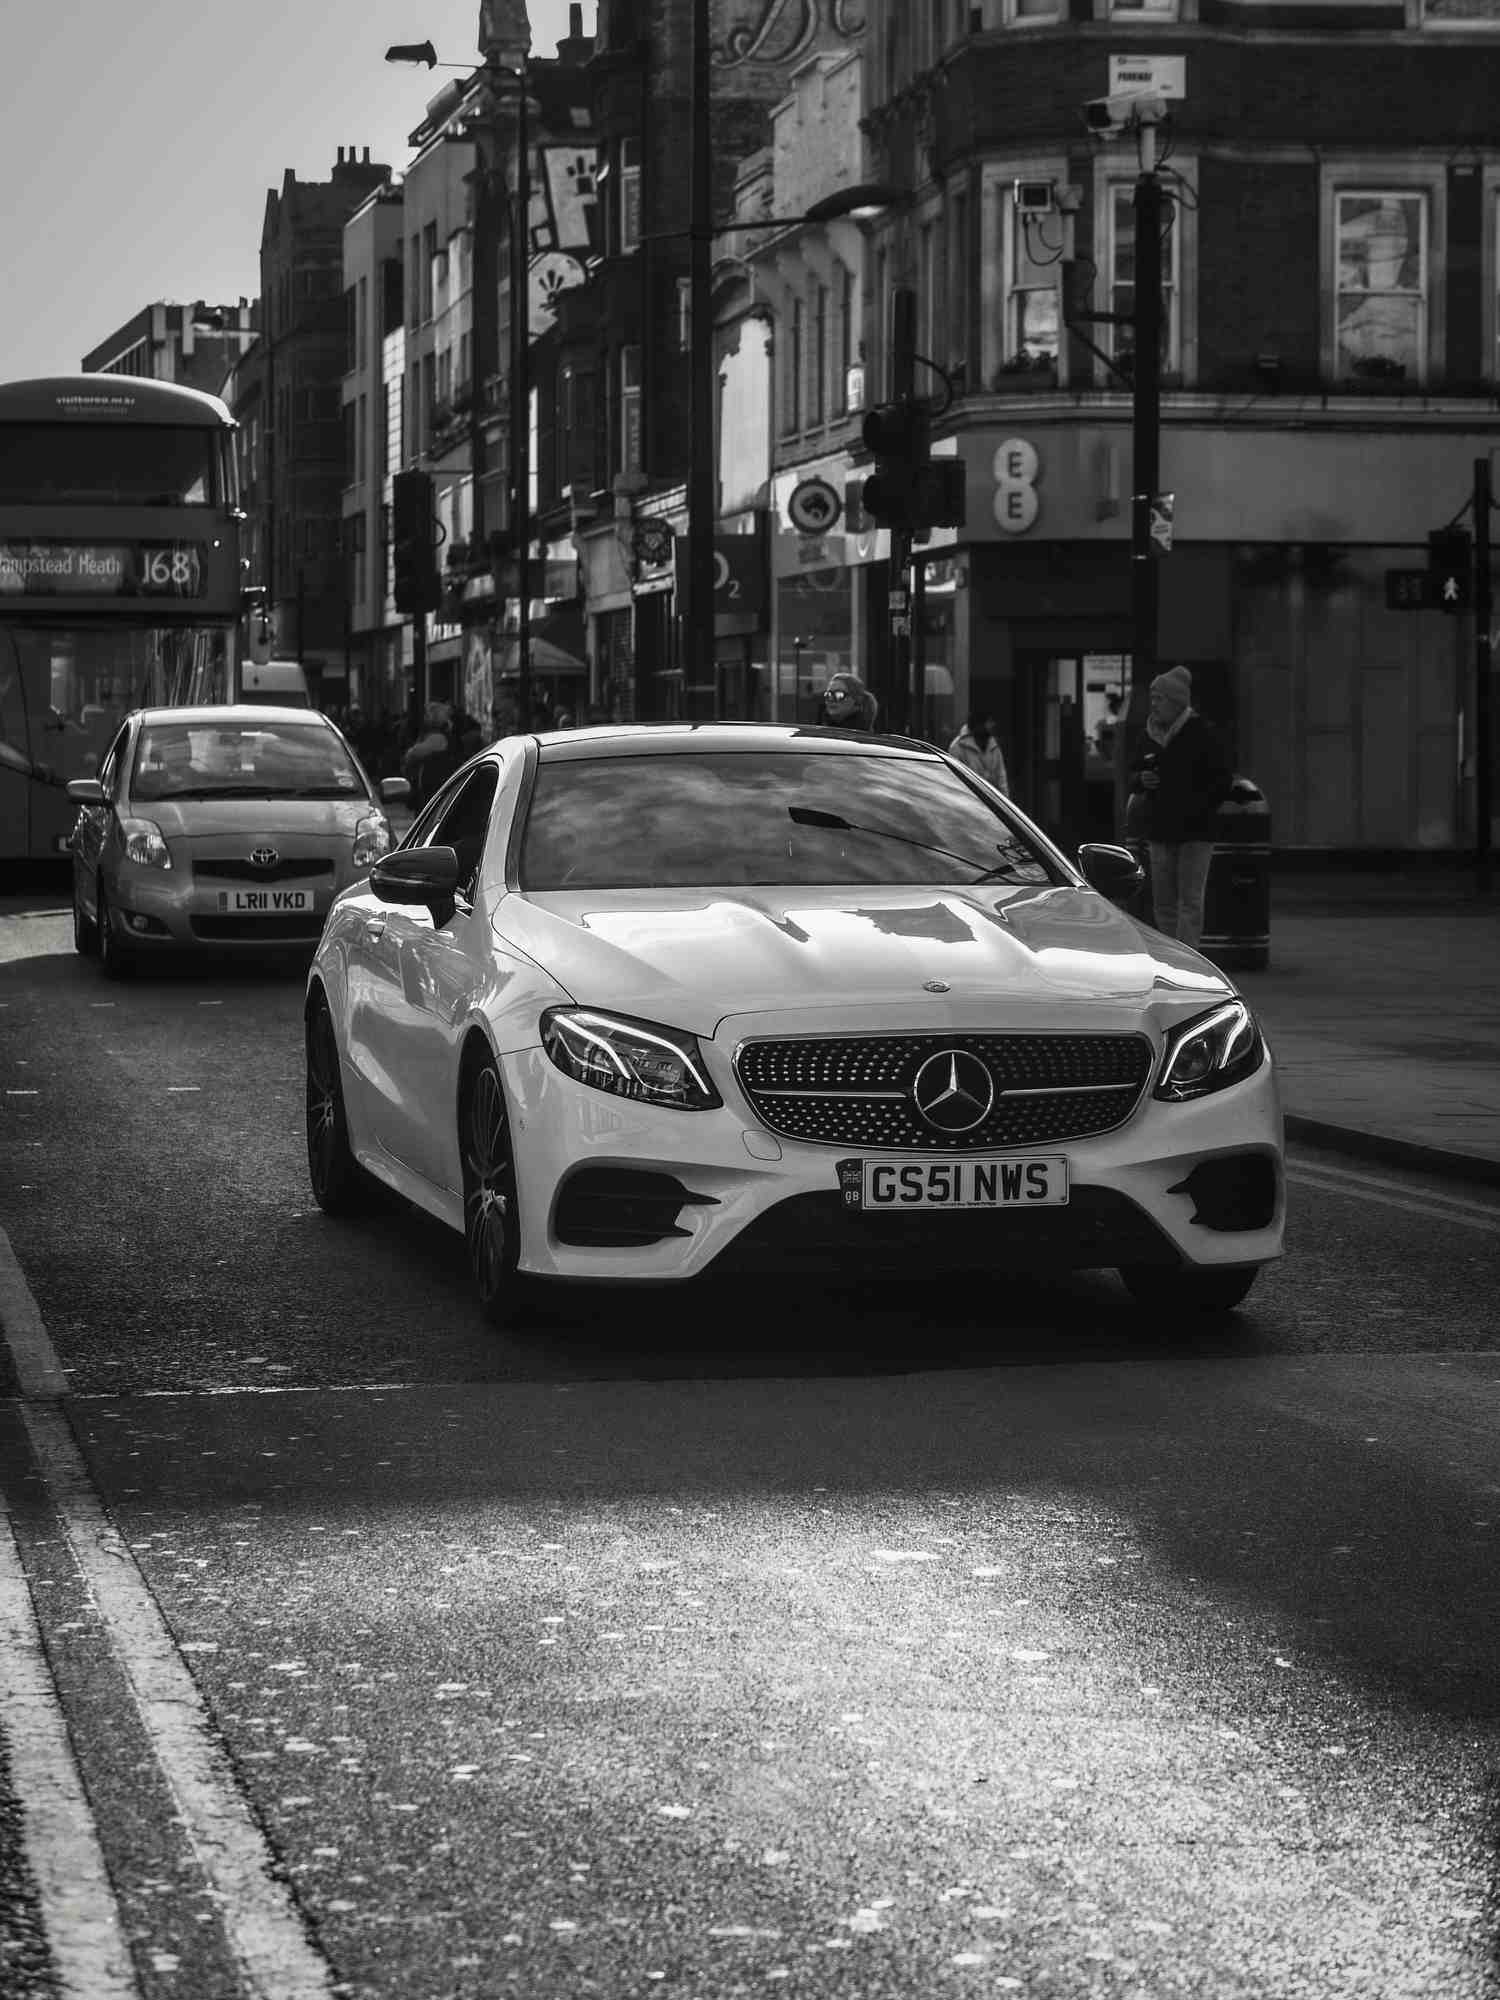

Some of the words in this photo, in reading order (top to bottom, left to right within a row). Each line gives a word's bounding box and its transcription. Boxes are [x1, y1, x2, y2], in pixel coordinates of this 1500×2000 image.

[0, 552, 72, 578] ampstead
[79, 553, 121, 575] Heath
[142, 551, 191, 584] 168
[272, 892, 305, 909] VKD
[974, 1163, 1048, 1201] NWS
